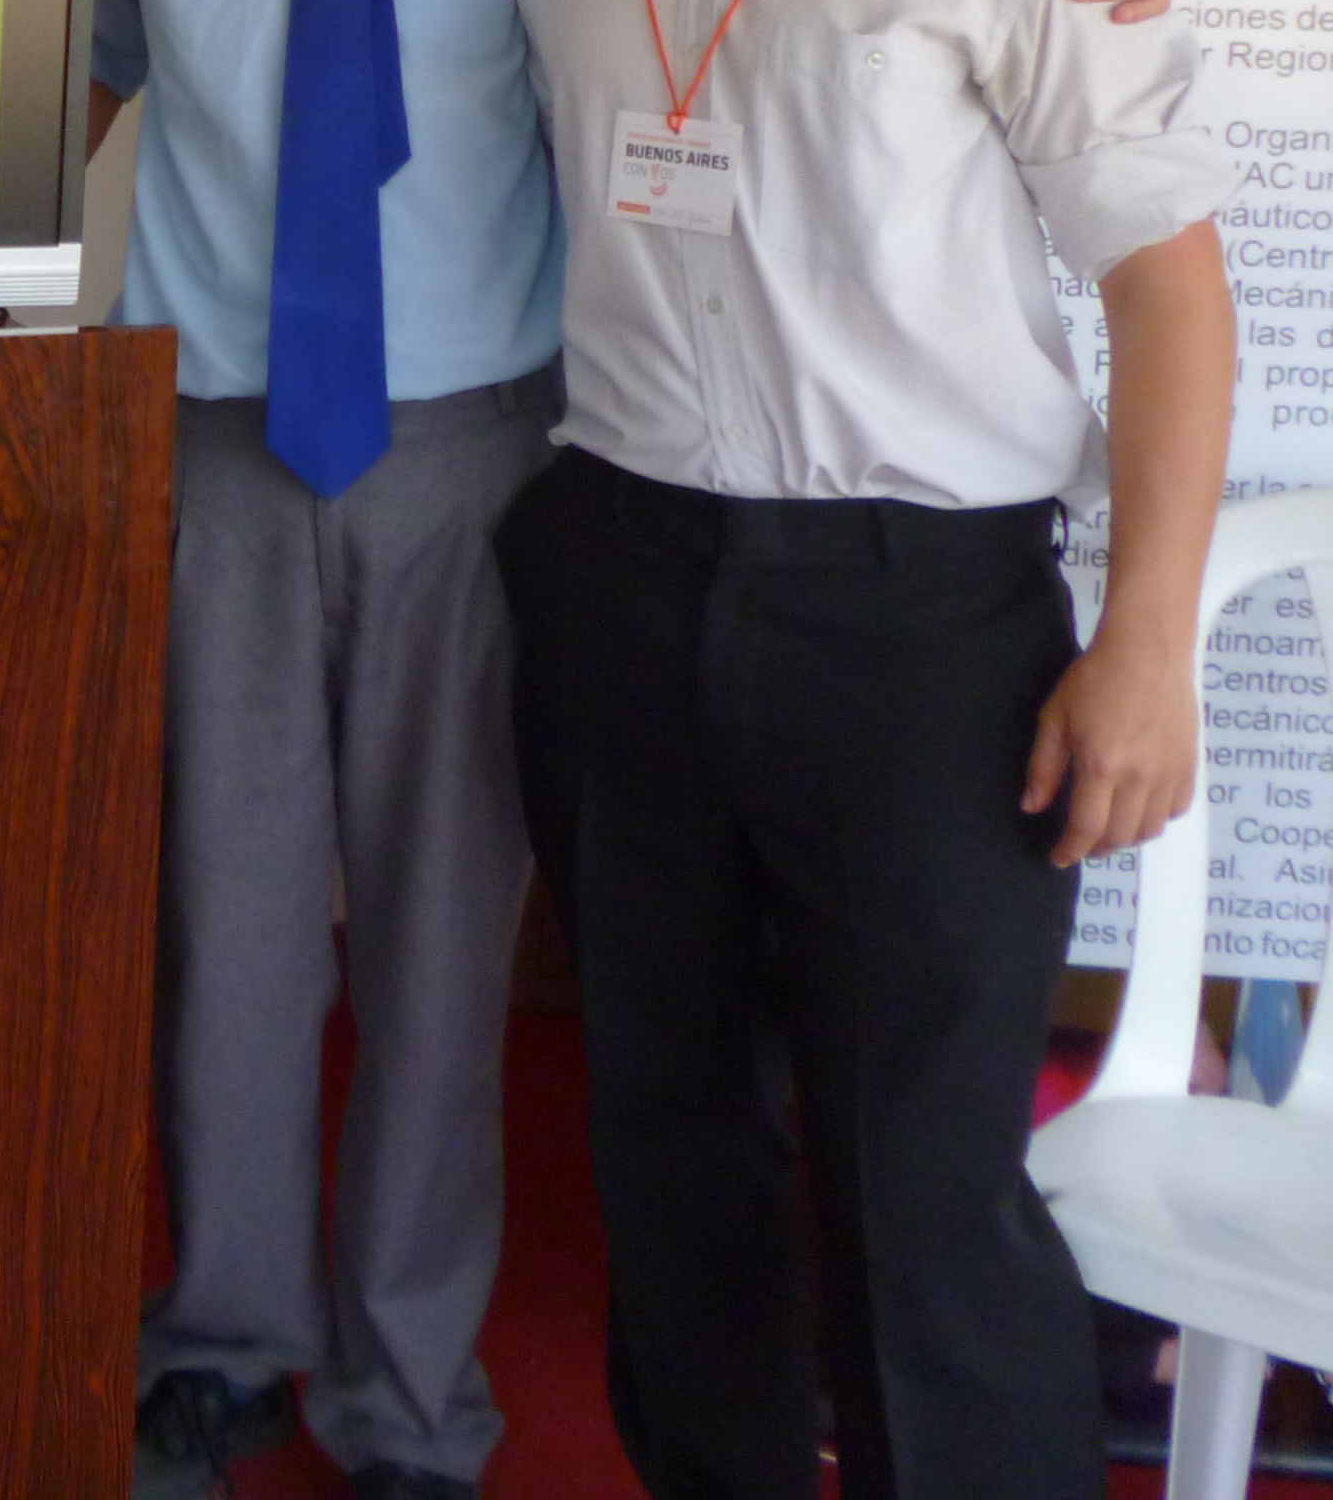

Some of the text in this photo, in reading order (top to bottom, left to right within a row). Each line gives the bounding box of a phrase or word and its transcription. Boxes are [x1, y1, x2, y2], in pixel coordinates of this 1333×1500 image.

[1227, 41, 1332, 78] Regio
[625, 142, 730, 171] BUENOS AIRES
[1249, 318, 1296, 347] las
[1265, 780, 1312, 809] los
